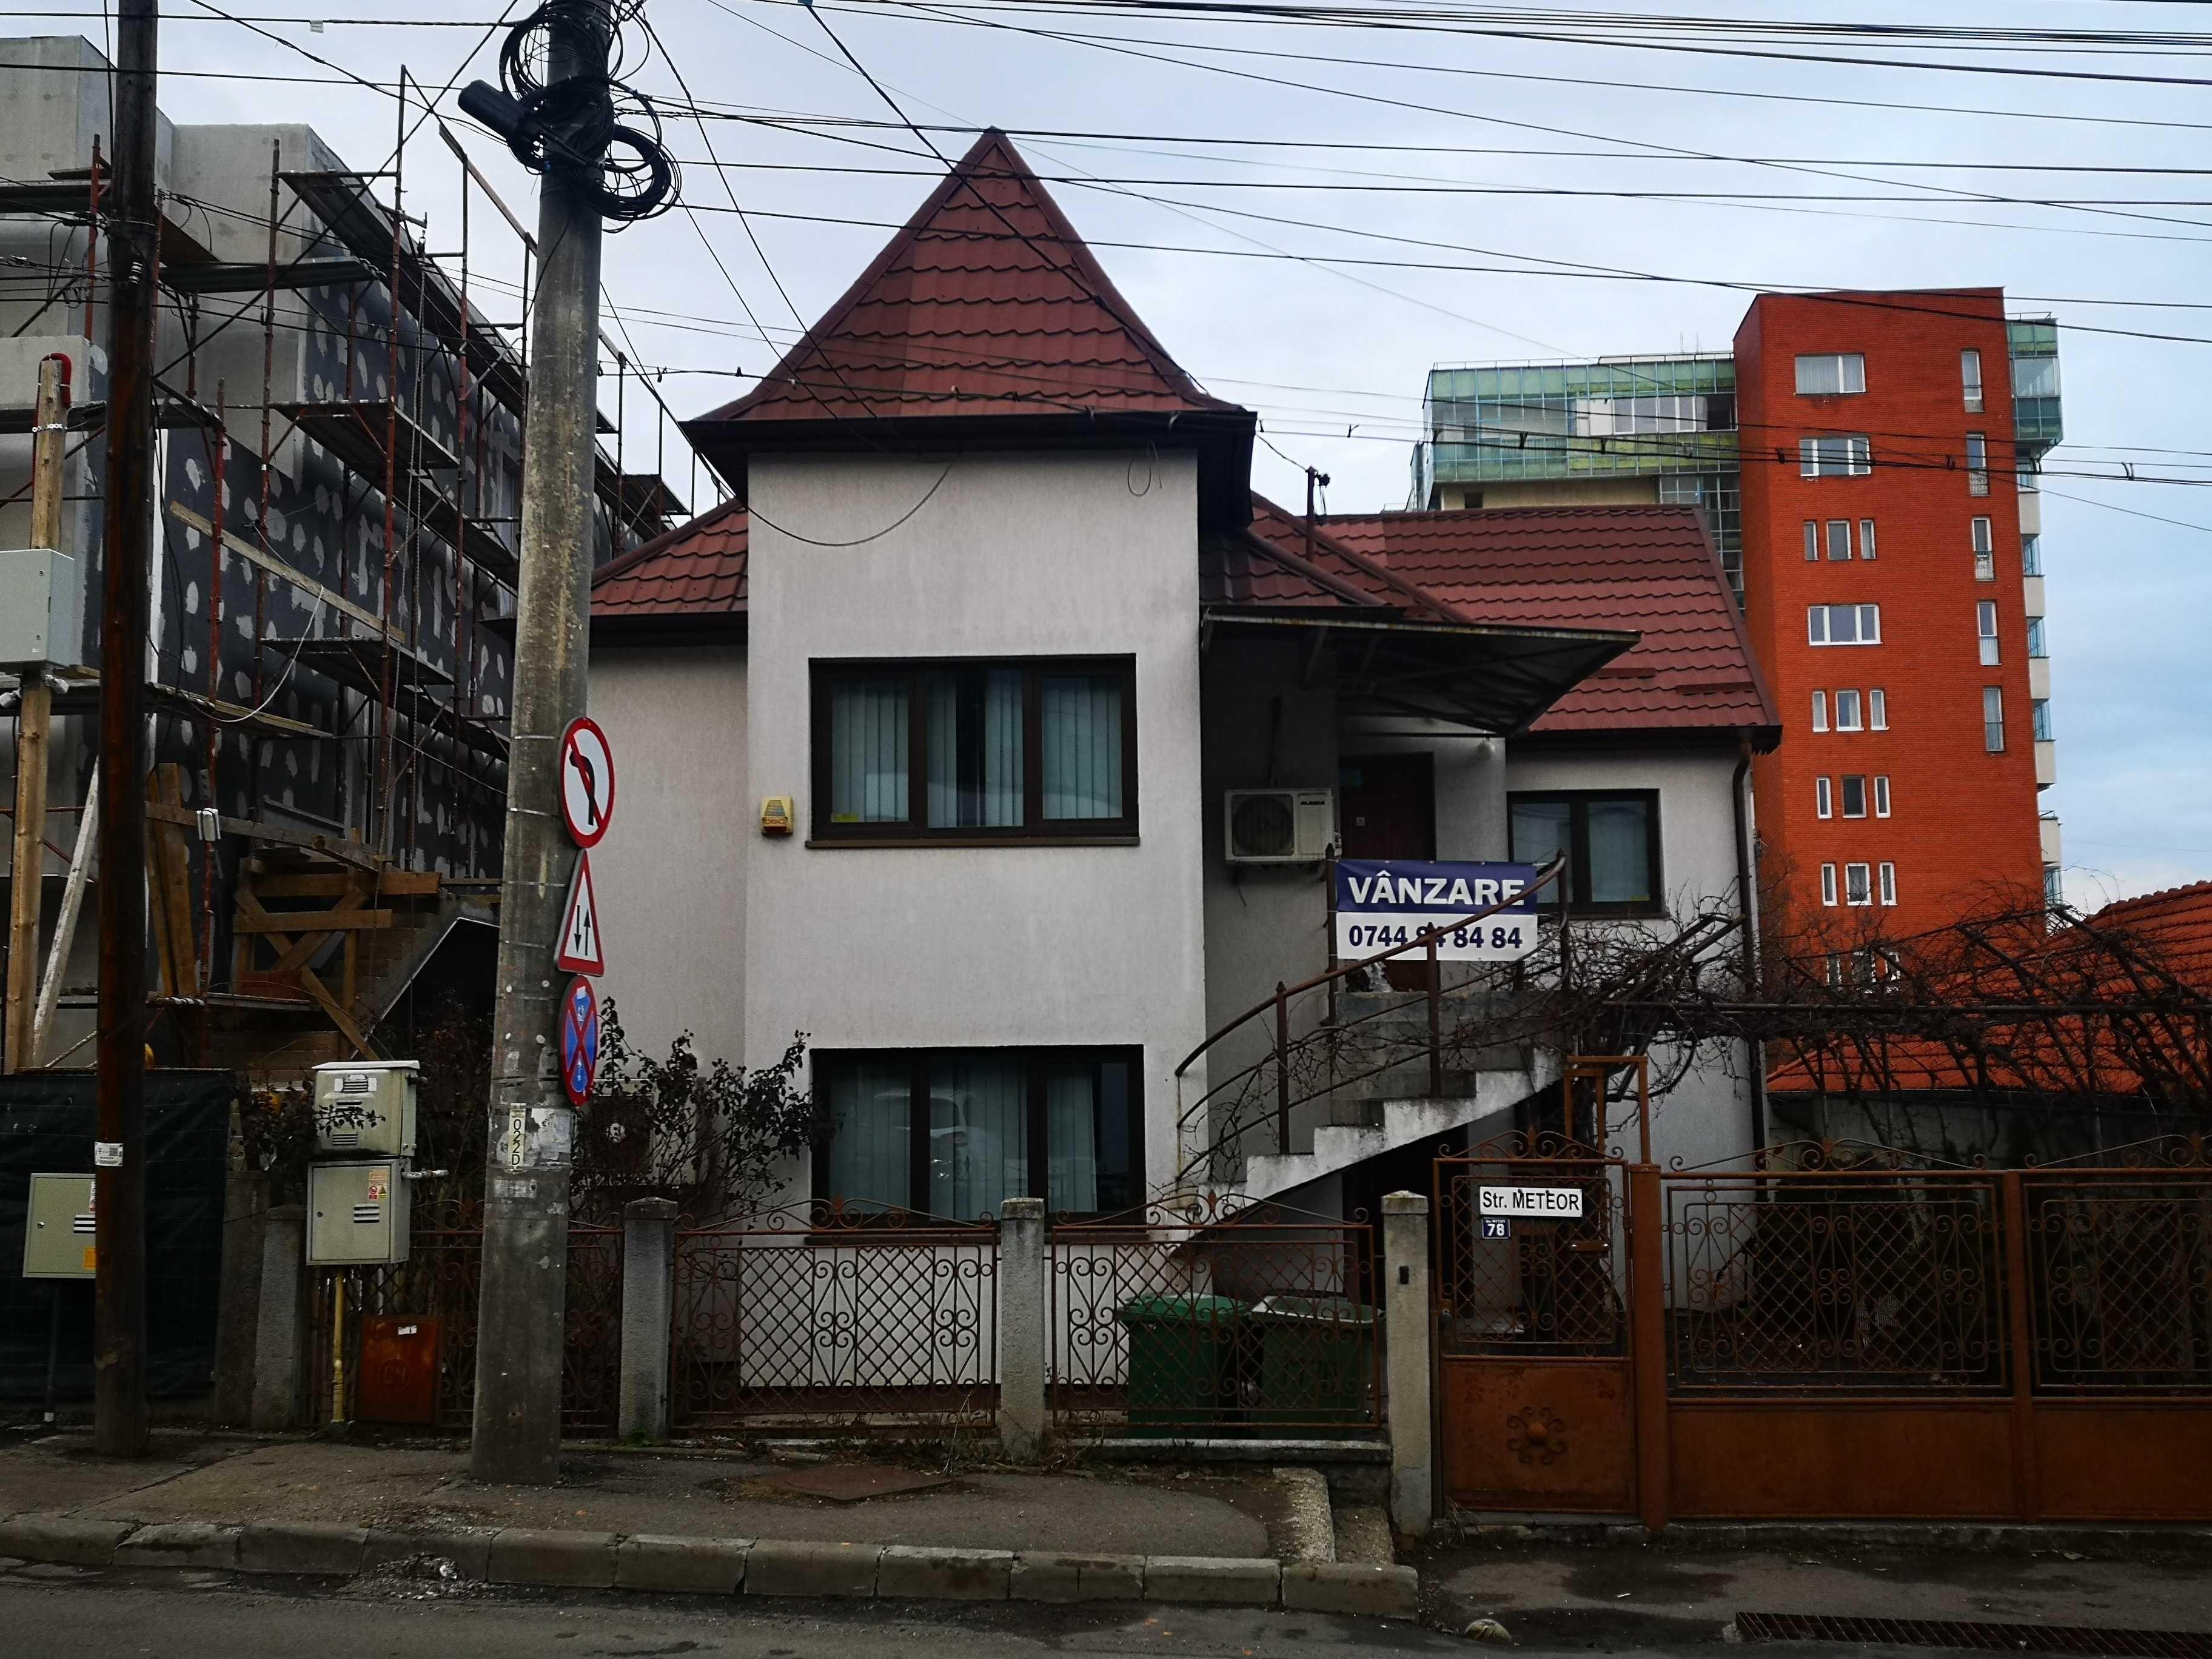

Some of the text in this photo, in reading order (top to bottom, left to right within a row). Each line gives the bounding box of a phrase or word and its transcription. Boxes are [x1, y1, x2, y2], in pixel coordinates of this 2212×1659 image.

[1348, 870, 1524, 905] VÂNZARE
[1349, 925, 1407, 947] 0744
[1453, 927, 1484, 948] 84
[1492, 927, 1523, 949] 84
[512, 1119, 521, 1165] 022D
[1483, 1191, 1579, 1210] Str. METEOR
[1487, 1224, 1504, 1236] 78
